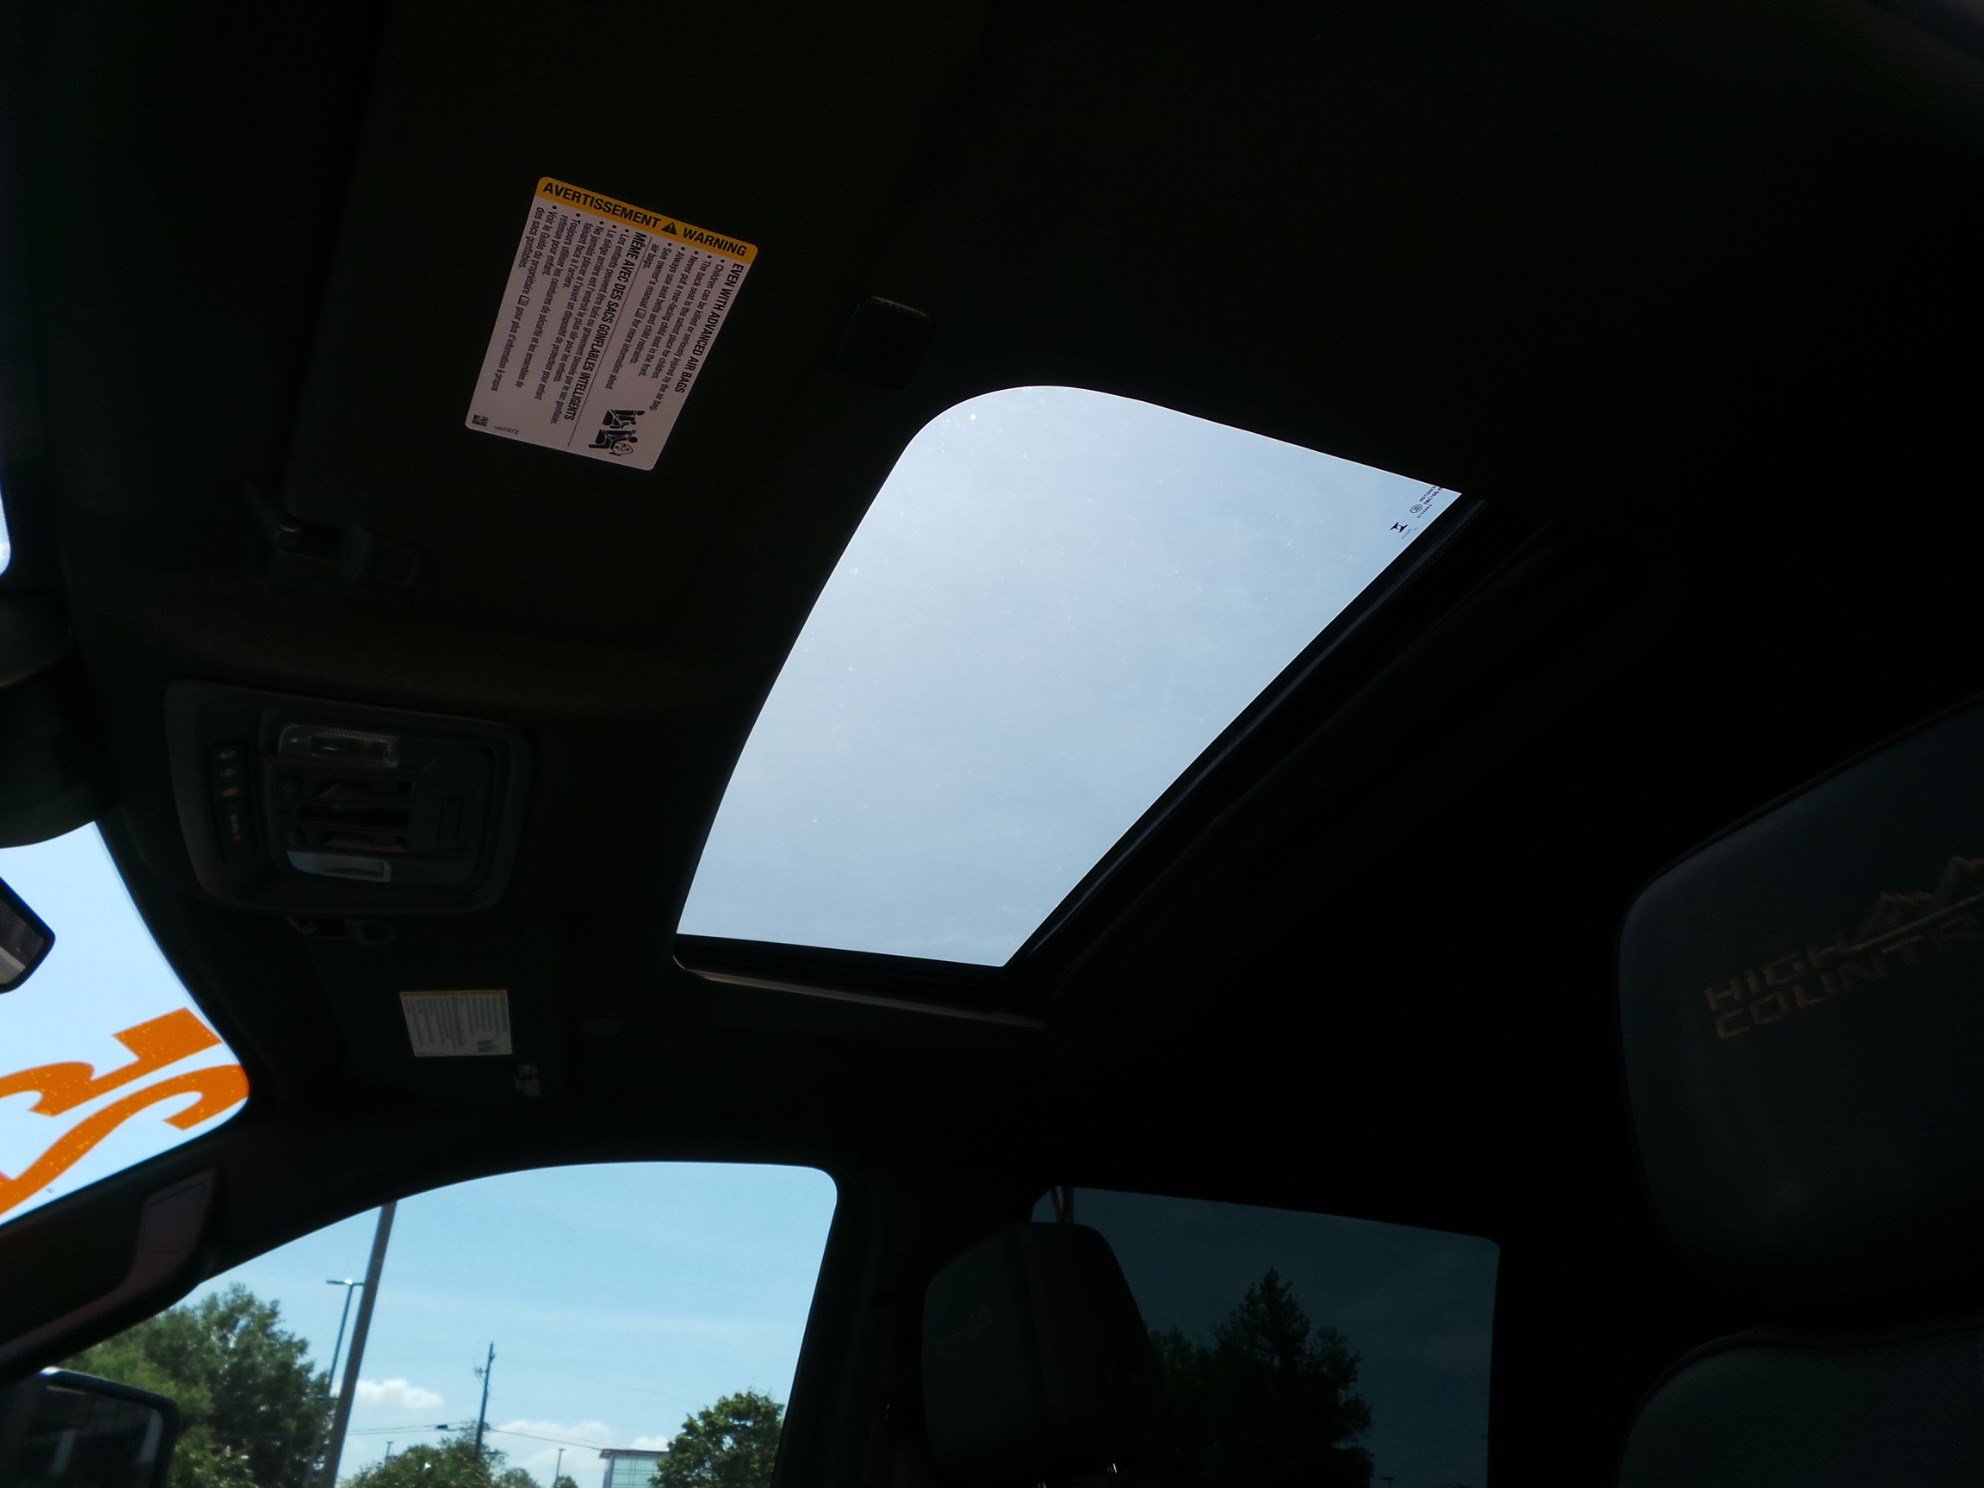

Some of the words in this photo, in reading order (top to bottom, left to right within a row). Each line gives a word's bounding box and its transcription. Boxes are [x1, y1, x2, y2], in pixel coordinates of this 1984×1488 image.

[534, 207, 545, 220] des
[543, 182, 661, 228] AVERTISSEMENT
[683, 227, 747, 256] WARNING
[545, 212, 557, 225] Voir
[529, 221, 540, 236] sacs
[554, 215, 568, 239] retenue
[564, 220, 581, 245] Toujours
[578, 223, 593, 244] faisant
[537, 232, 550, 250] Guide
[550, 240, 560, 255] pour
[586, 235, 600, 256] jamais
[618, 234, 629, 245] Les
[626, 232, 647, 260] MÊME
[573, 245, 585, 258] face
[651, 244, 659, 253] air
[660, 248, 672, 260] See
[557, 246, 569, 268] utiliser
[609, 246, 623, 268] enfants
[643, 253, 657, 269] bags.
[669, 251, 685, 273] Always
[684, 256, 698, 274] Never
[553, 268, 564, 277] les
[579, 256, 591, 276] placer
[617, 259, 635, 283] AVEC
[649, 261, 664, 285] owner's
[700, 261, 711, 271] The
[588, 277, 597, 287] est
[599, 269, 613, 293] peuvent
[664, 274, 673, 285] use
[679, 274, 688, 285] put
[693, 272, 706, 287] back
[707, 264, 724, 289] Children
[724, 263, 744, 287] EVEN
[544, 278, 558, 305] ceintures
[579, 287, 595, 311] l'endroit
[595, 293, 606, 305] être
[610, 283, 626, 300] DES
[640, 286, 653, 308] manual
[658, 285, 669, 299] seat
[687, 287, 697, 300] seat
[701, 290, 711, 301] can
[713, 288, 733, 311] WITH
[514, 306, 524, 321] pour
[602, 301, 619, 323] SACS
[652, 299, 665, 313] belts
[662, 290, 681, 321] rear-facing
[680, 307, 690, 316] the
[558, 311, 573, 337] dispositif
[572, 318, 582, 330] plus
[632, 319, 642, 328] for
[647, 314, 657, 325] and
[672, 317, 684, 334] safest
[690, 310, 703, 326] killed
[510, 321, 520, 333] plus
[641, 325, 652, 339] child
[657, 322, 668, 336] child
[692, 311, 721, 356] ADVANCED
[576, 327, 591, 356] gravement
[625, 328, 636, 343] more
[651, 336, 662, 348] seat
[665, 334, 677, 349] place
[528, 344, 538, 352] les
[565, 340, 574, 353] pour
[583, 324, 610, 372] GONFLABLES
[630, 339, 646, 364] restraints.
[674, 334, 691, 357] seriously
[546, 344, 560, 371] protection
[561, 354, 570, 362] les
[613, 344, 631, 373] information
[645, 354, 654, 362] the
[662, 350, 671, 358] for
[518, 353, 533, 380] ensembles
[639, 363, 651, 376] front.
[651, 358, 666, 379] children.
[667, 358, 681, 376] injured
[685, 356, 699, 371] AIR
[541, 371, 550, 383] pour
[554, 363, 566, 382] enfants.
[565, 376, 573, 385] par
[491, 373, 502, 391] propos
[605, 374, 617, 389] about
[659, 384, 669, 392] the
[675, 372, 692, 393] BAGS
[535, 384, 545, 400] enfant
[559, 391, 567, 401] sac
[564, 372, 591, 420] INTELLIGENTS
[649, 400, 661, 410] bag.
[1703, 933, 1848, 1011] HIGH
